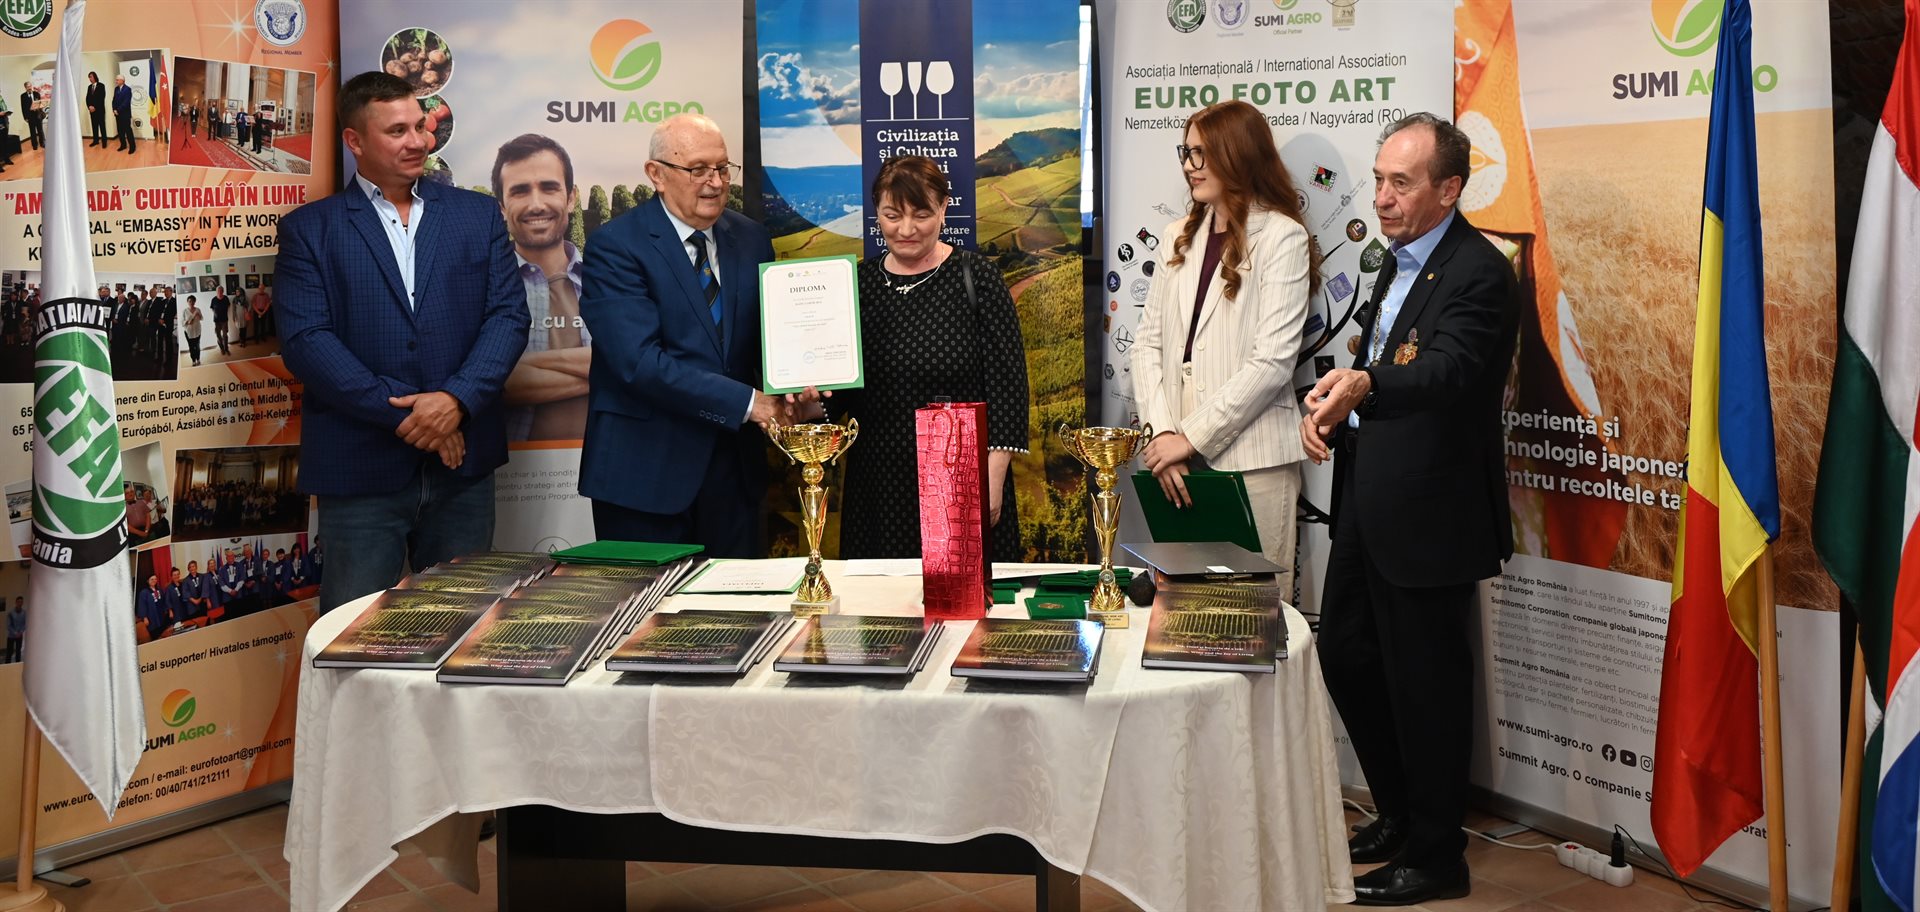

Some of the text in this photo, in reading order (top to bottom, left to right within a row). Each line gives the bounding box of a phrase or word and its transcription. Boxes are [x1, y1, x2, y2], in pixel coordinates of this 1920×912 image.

[7, 0, 36, 15] EFA
[1179, 4, 1196, 17] EFA
[1254, 15, 1284, 27] SUMI
[1287, 12, 1322, 25] AGRO
[1125, 52, 1407, 80] Asociația Internațională International Association
[1135, 77, 1396, 109] EURO FOTO ART
[1612, 71, 1679, 100] SUMI
[546, 101, 616, 123] SUMI
[1124, 115, 1190, 130] Nemzetköz
[1311, 110, 1374, 127] Nagyvárad
[877, 128, 961, 147] Civilizația
[896, 145, 959, 158] Cultura
[135, 183, 236, 211] CULTURALĂ
[239, 182, 258, 206] ÎN
[263, 184, 306, 206] LUME
[23, 224, 34, 238] A
[199, 216, 211, 230] IN
[216, 215, 242, 229] THE
[210, 238, 220, 250] A
[790, 285, 826, 294] DIPLOMA
[542, 315, 566, 329] cu
[142, 392, 156, 404] din
[158, 387, 193, 402] Europa,
[196, 385, 215, 397] Asia
[229, 379, 265, 393] Orientul
[21, 393, 288, 420] 65 from Europe, Asia and the Middle
[13, 425, 25, 436] 65
[177, 413, 216, 433] Ázsiából
[218, 416, 228, 425] és
[230, 416, 237, 424] a
[36, 366, 122, 498] EFA
[1602, 416, 1620, 443] și
[1560, 478, 1656, 506] recoltele
[1518, 575, 1535, 586] Agro
[1536, 579, 1568, 593] România
[1490, 581, 1507, 592] Agro
[1628, 609, 1668, 625] Sumitomo
[1490, 595, 1526, 610] Sumitomo
[1573, 613, 1608, 629] companie
[1609, 620, 1637, 635] globală
[209, 641, 250, 658] Hivatalos
[252, 630, 296, 649] támogató:
[1493, 654, 1520, 667] Summit
[1521, 661, 1539, 672] Agro
[1540, 665, 1571, 680] România
[177, 722, 217, 744] AGRO
[1498, 717, 1593, 754] www.sumi-agro.ro
[156, 737, 292, 784] e-mail: eurofotoart@gmail.com
[1498, 747, 1643, 797] Summit Agro. O companie
[155, 768, 231, 798] 00/40/741/212111
